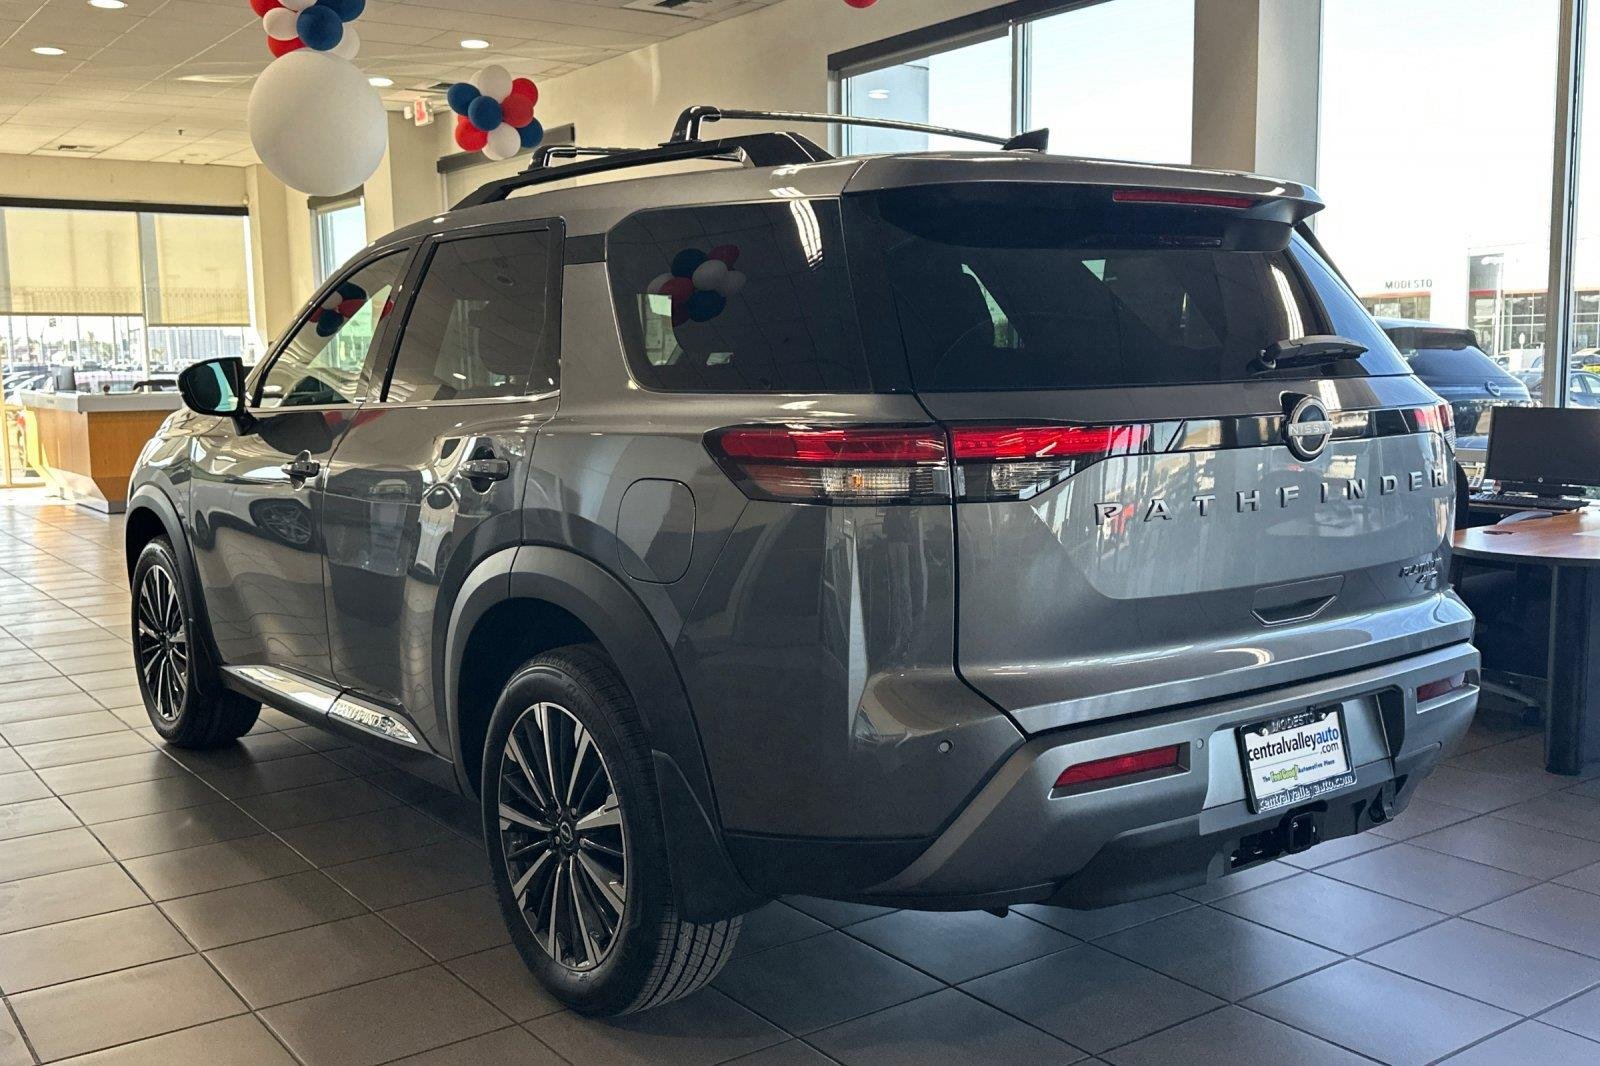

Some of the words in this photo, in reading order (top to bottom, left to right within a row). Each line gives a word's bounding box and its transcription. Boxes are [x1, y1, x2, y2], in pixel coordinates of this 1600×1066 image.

[1094, 468, 1447, 525] PATHFINDER
[1248, 727, 1339, 761] centralvalleyauto
[1320, 742, 1339, 755] .com
